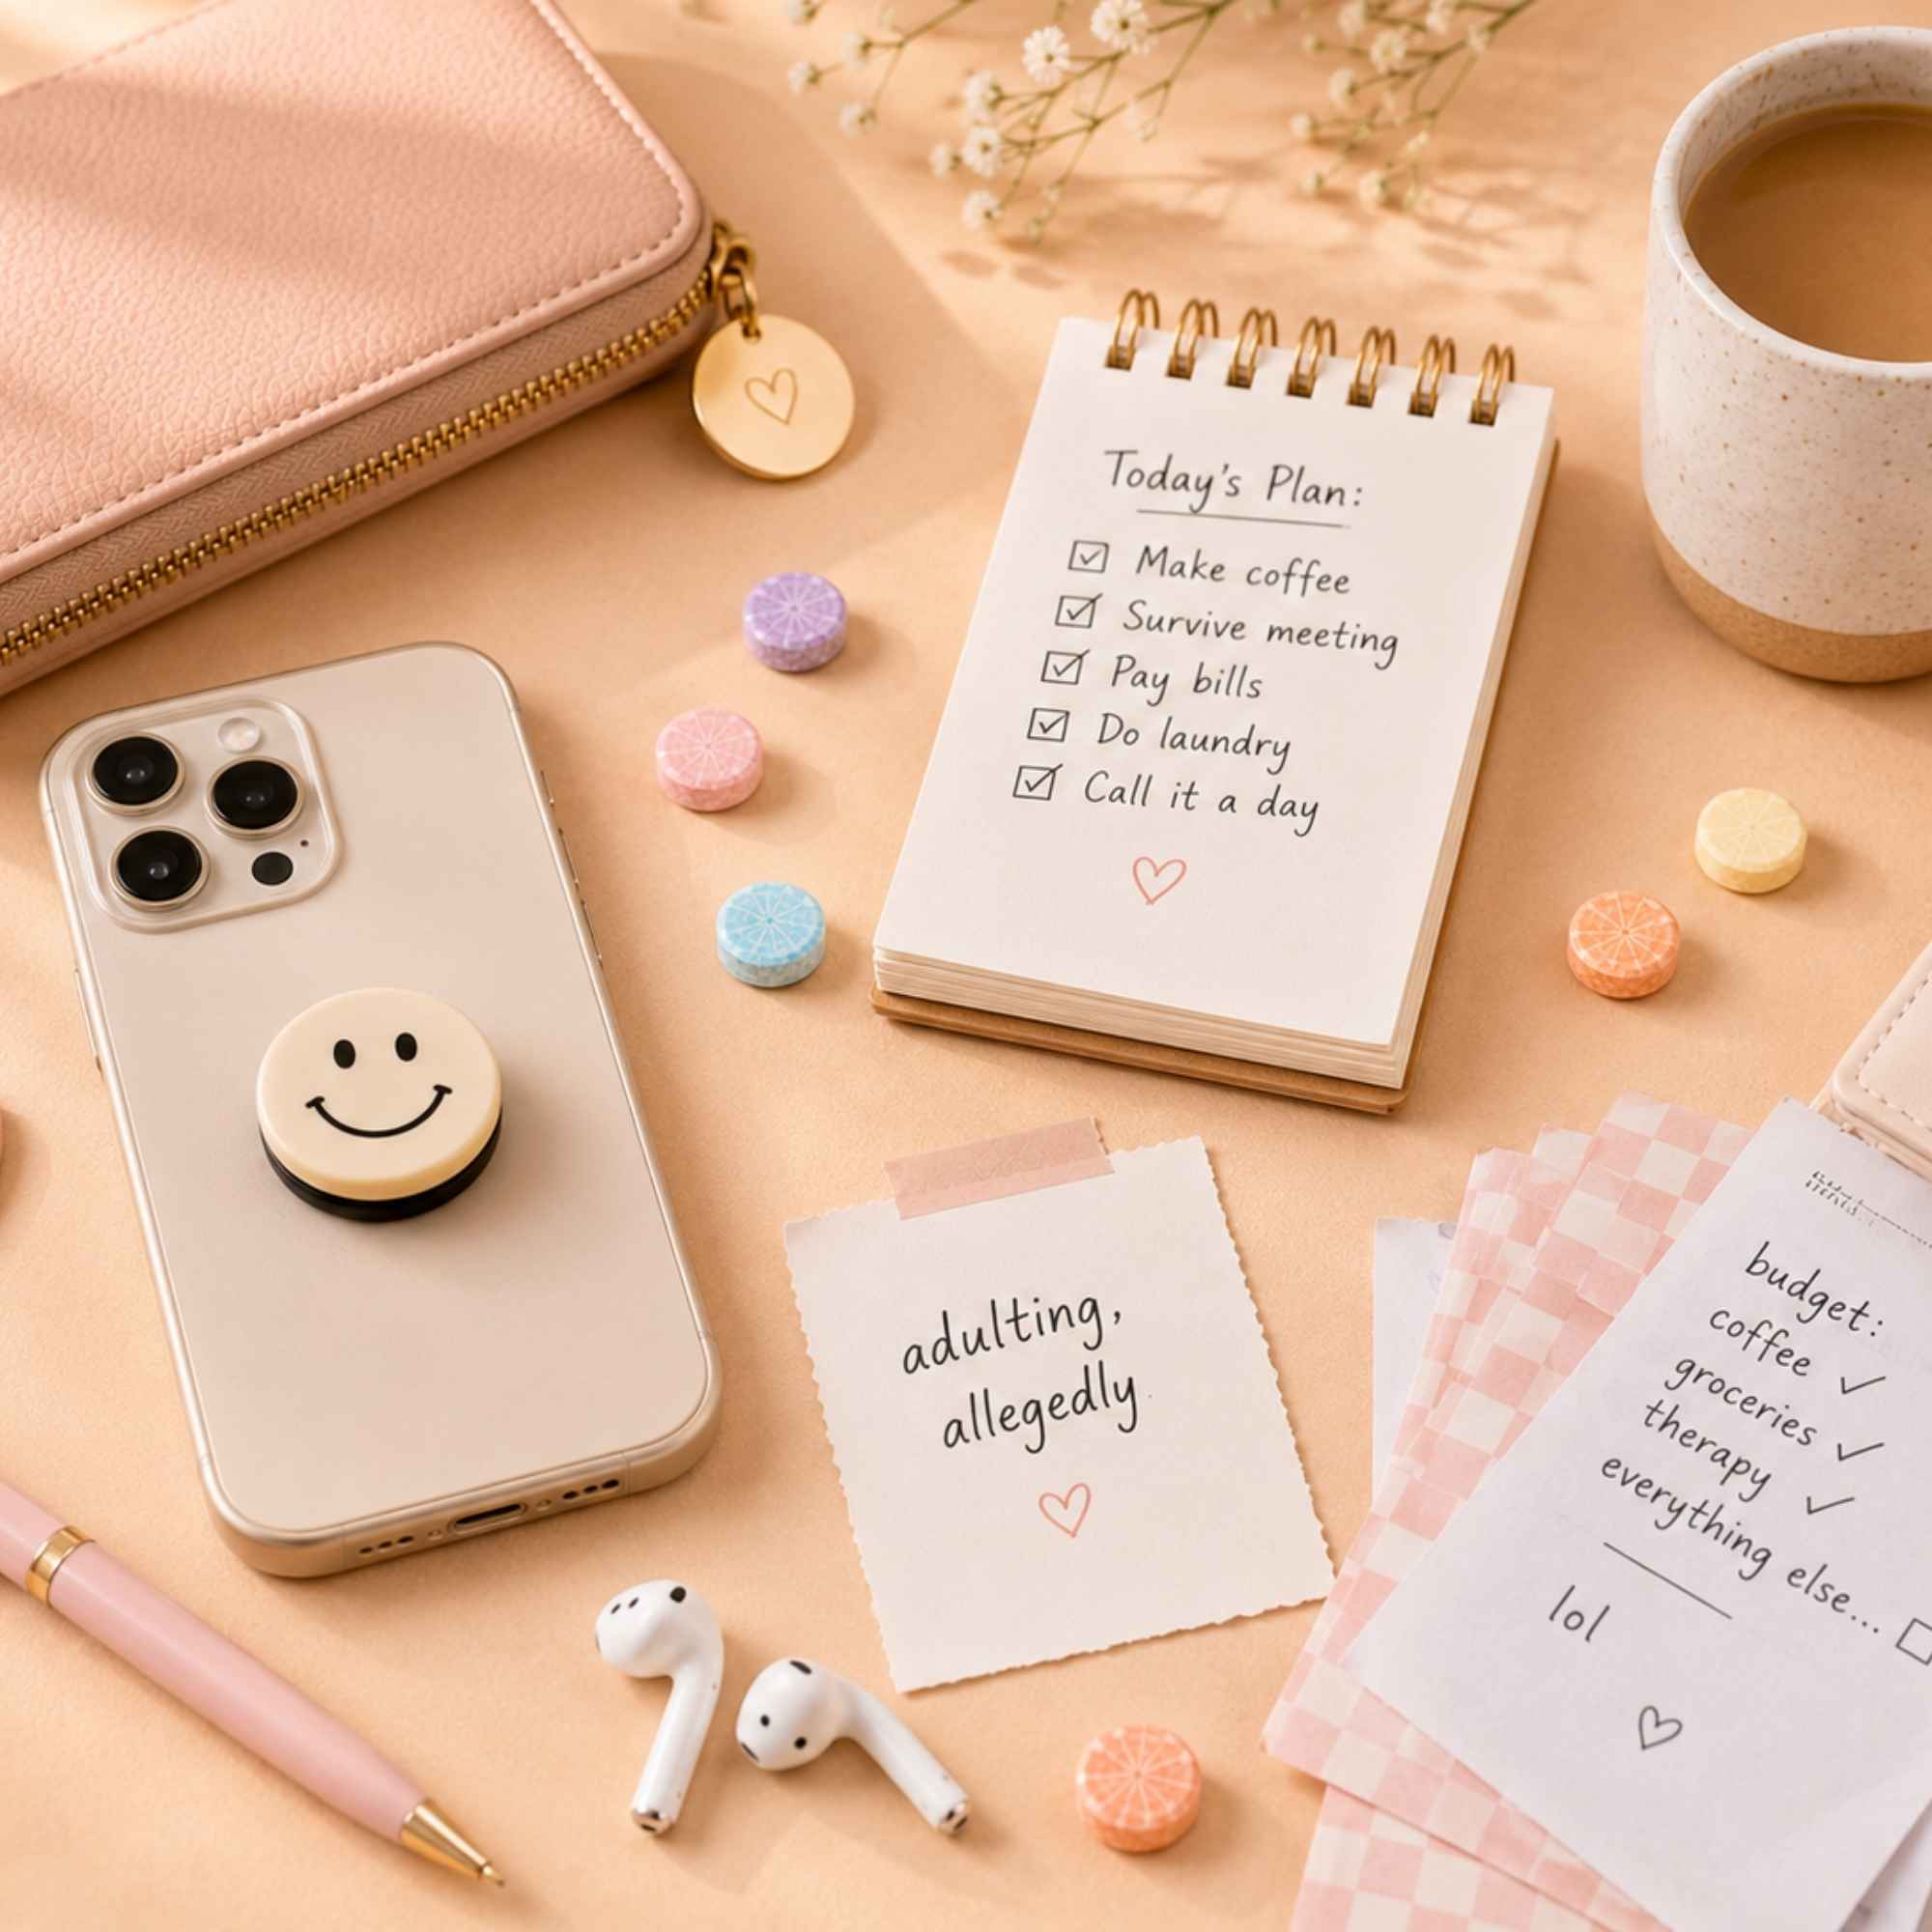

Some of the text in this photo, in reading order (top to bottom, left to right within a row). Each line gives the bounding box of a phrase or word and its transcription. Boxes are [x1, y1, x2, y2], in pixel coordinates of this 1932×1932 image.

[1104, 449, 1362, 514] Today's Plan:
[1136, 545, 1350, 597] Make coffee
[1122, 599, 1398, 670] Survive meeting
[1111, 655, 1263, 707] Pay bills
[1096, 712, 1291, 775] Do laundry
[1084, 770, 1319, 837] Call it a day
[1745, 1241, 1884, 1337] budget:
[903, 1296, 1121, 1374] adulting,
[1709, 1305, 1811, 1378] coffee
[944, 1359, 1137, 1454] allegedly
[1664, 1357, 1818, 1447] groceries
[1643, 1401, 1772, 1503] therapy
[1602, 1457, 1879, 1634] everything else...
[1548, 1585, 1610, 1642] lol
